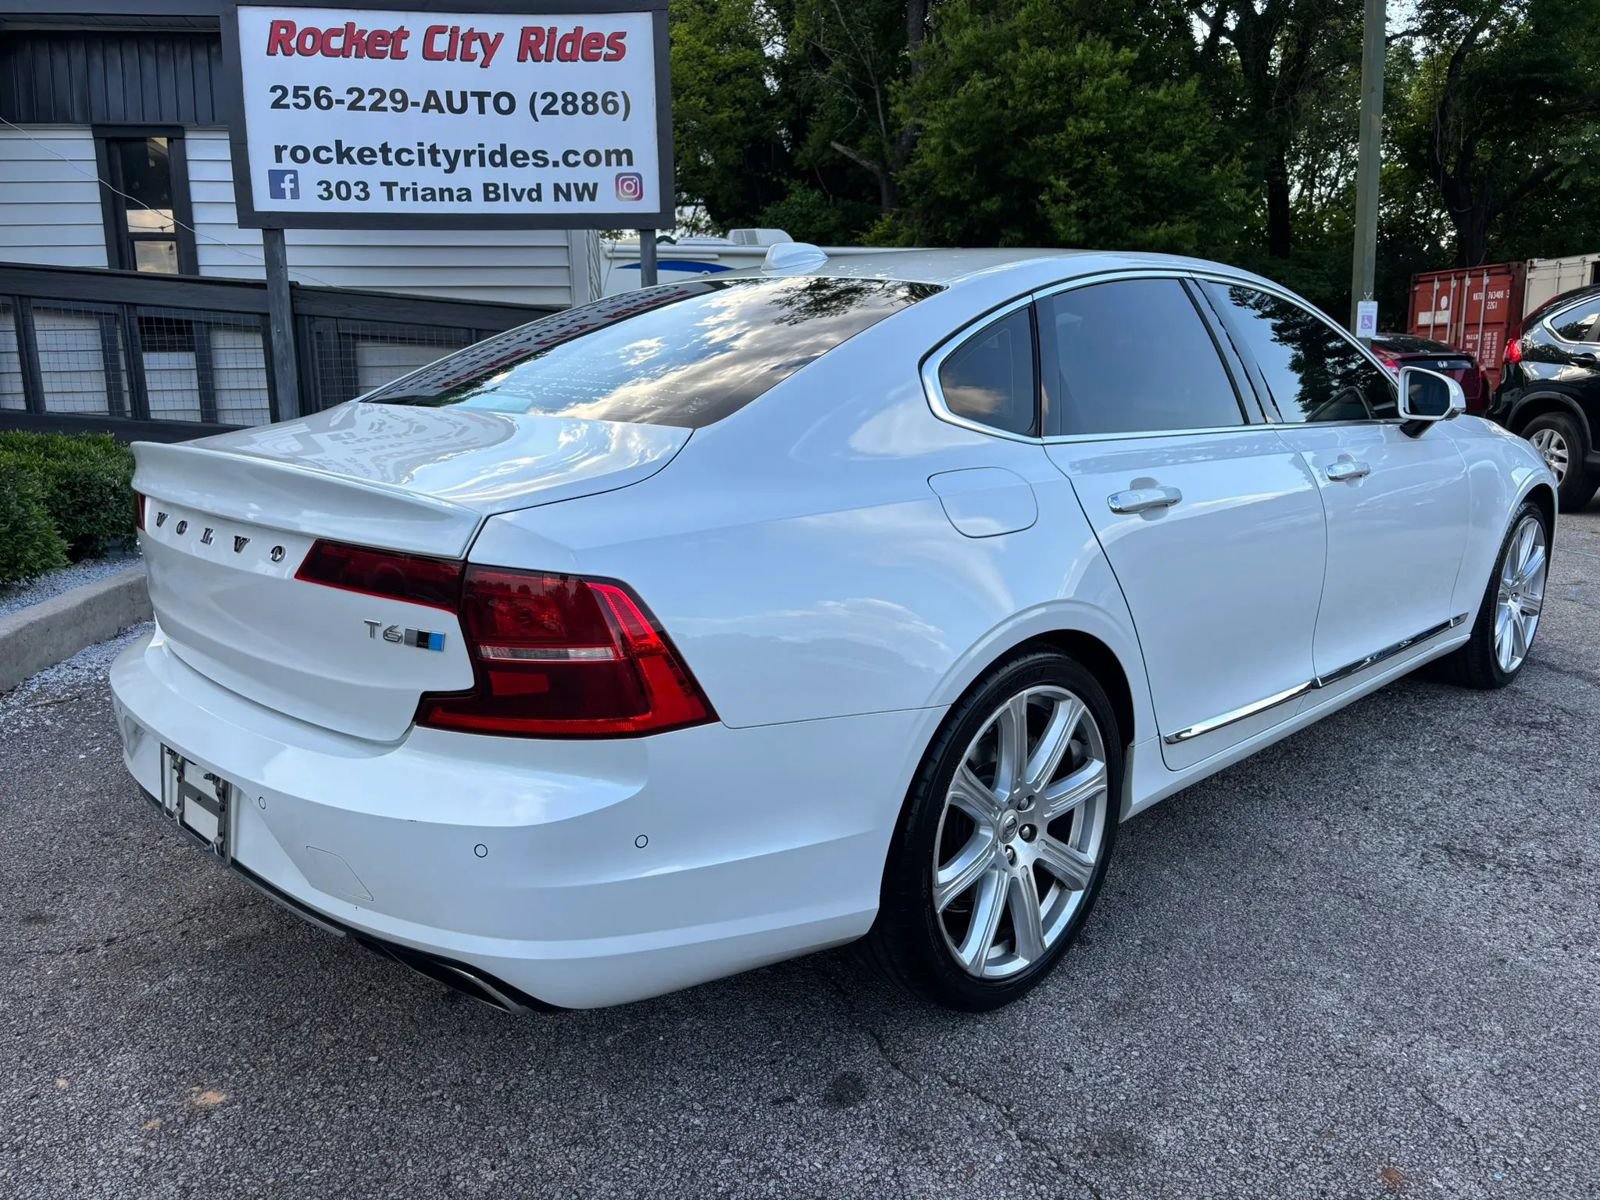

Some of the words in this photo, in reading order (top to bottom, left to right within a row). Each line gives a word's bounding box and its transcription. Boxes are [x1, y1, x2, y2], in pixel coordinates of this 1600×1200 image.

[267, 20, 410, 60] Rocket
[422, 25, 504, 68] City
[517, 26, 627, 63] Rides
[269, 85, 516, 116] 256-229-AUTO
[529, 90, 631, 121] (2886)
[274, 140, 633, 174] rocketcityrides.com
[317, 180, 370, 201] 303
[380, 181, 472, 202] Triana
[483, 182, 542, 203] Blvd
[553, 182, 599, 202] NW
[156, 511, 286, 563] VOLVO
[363, 619, 403, 643] T6
